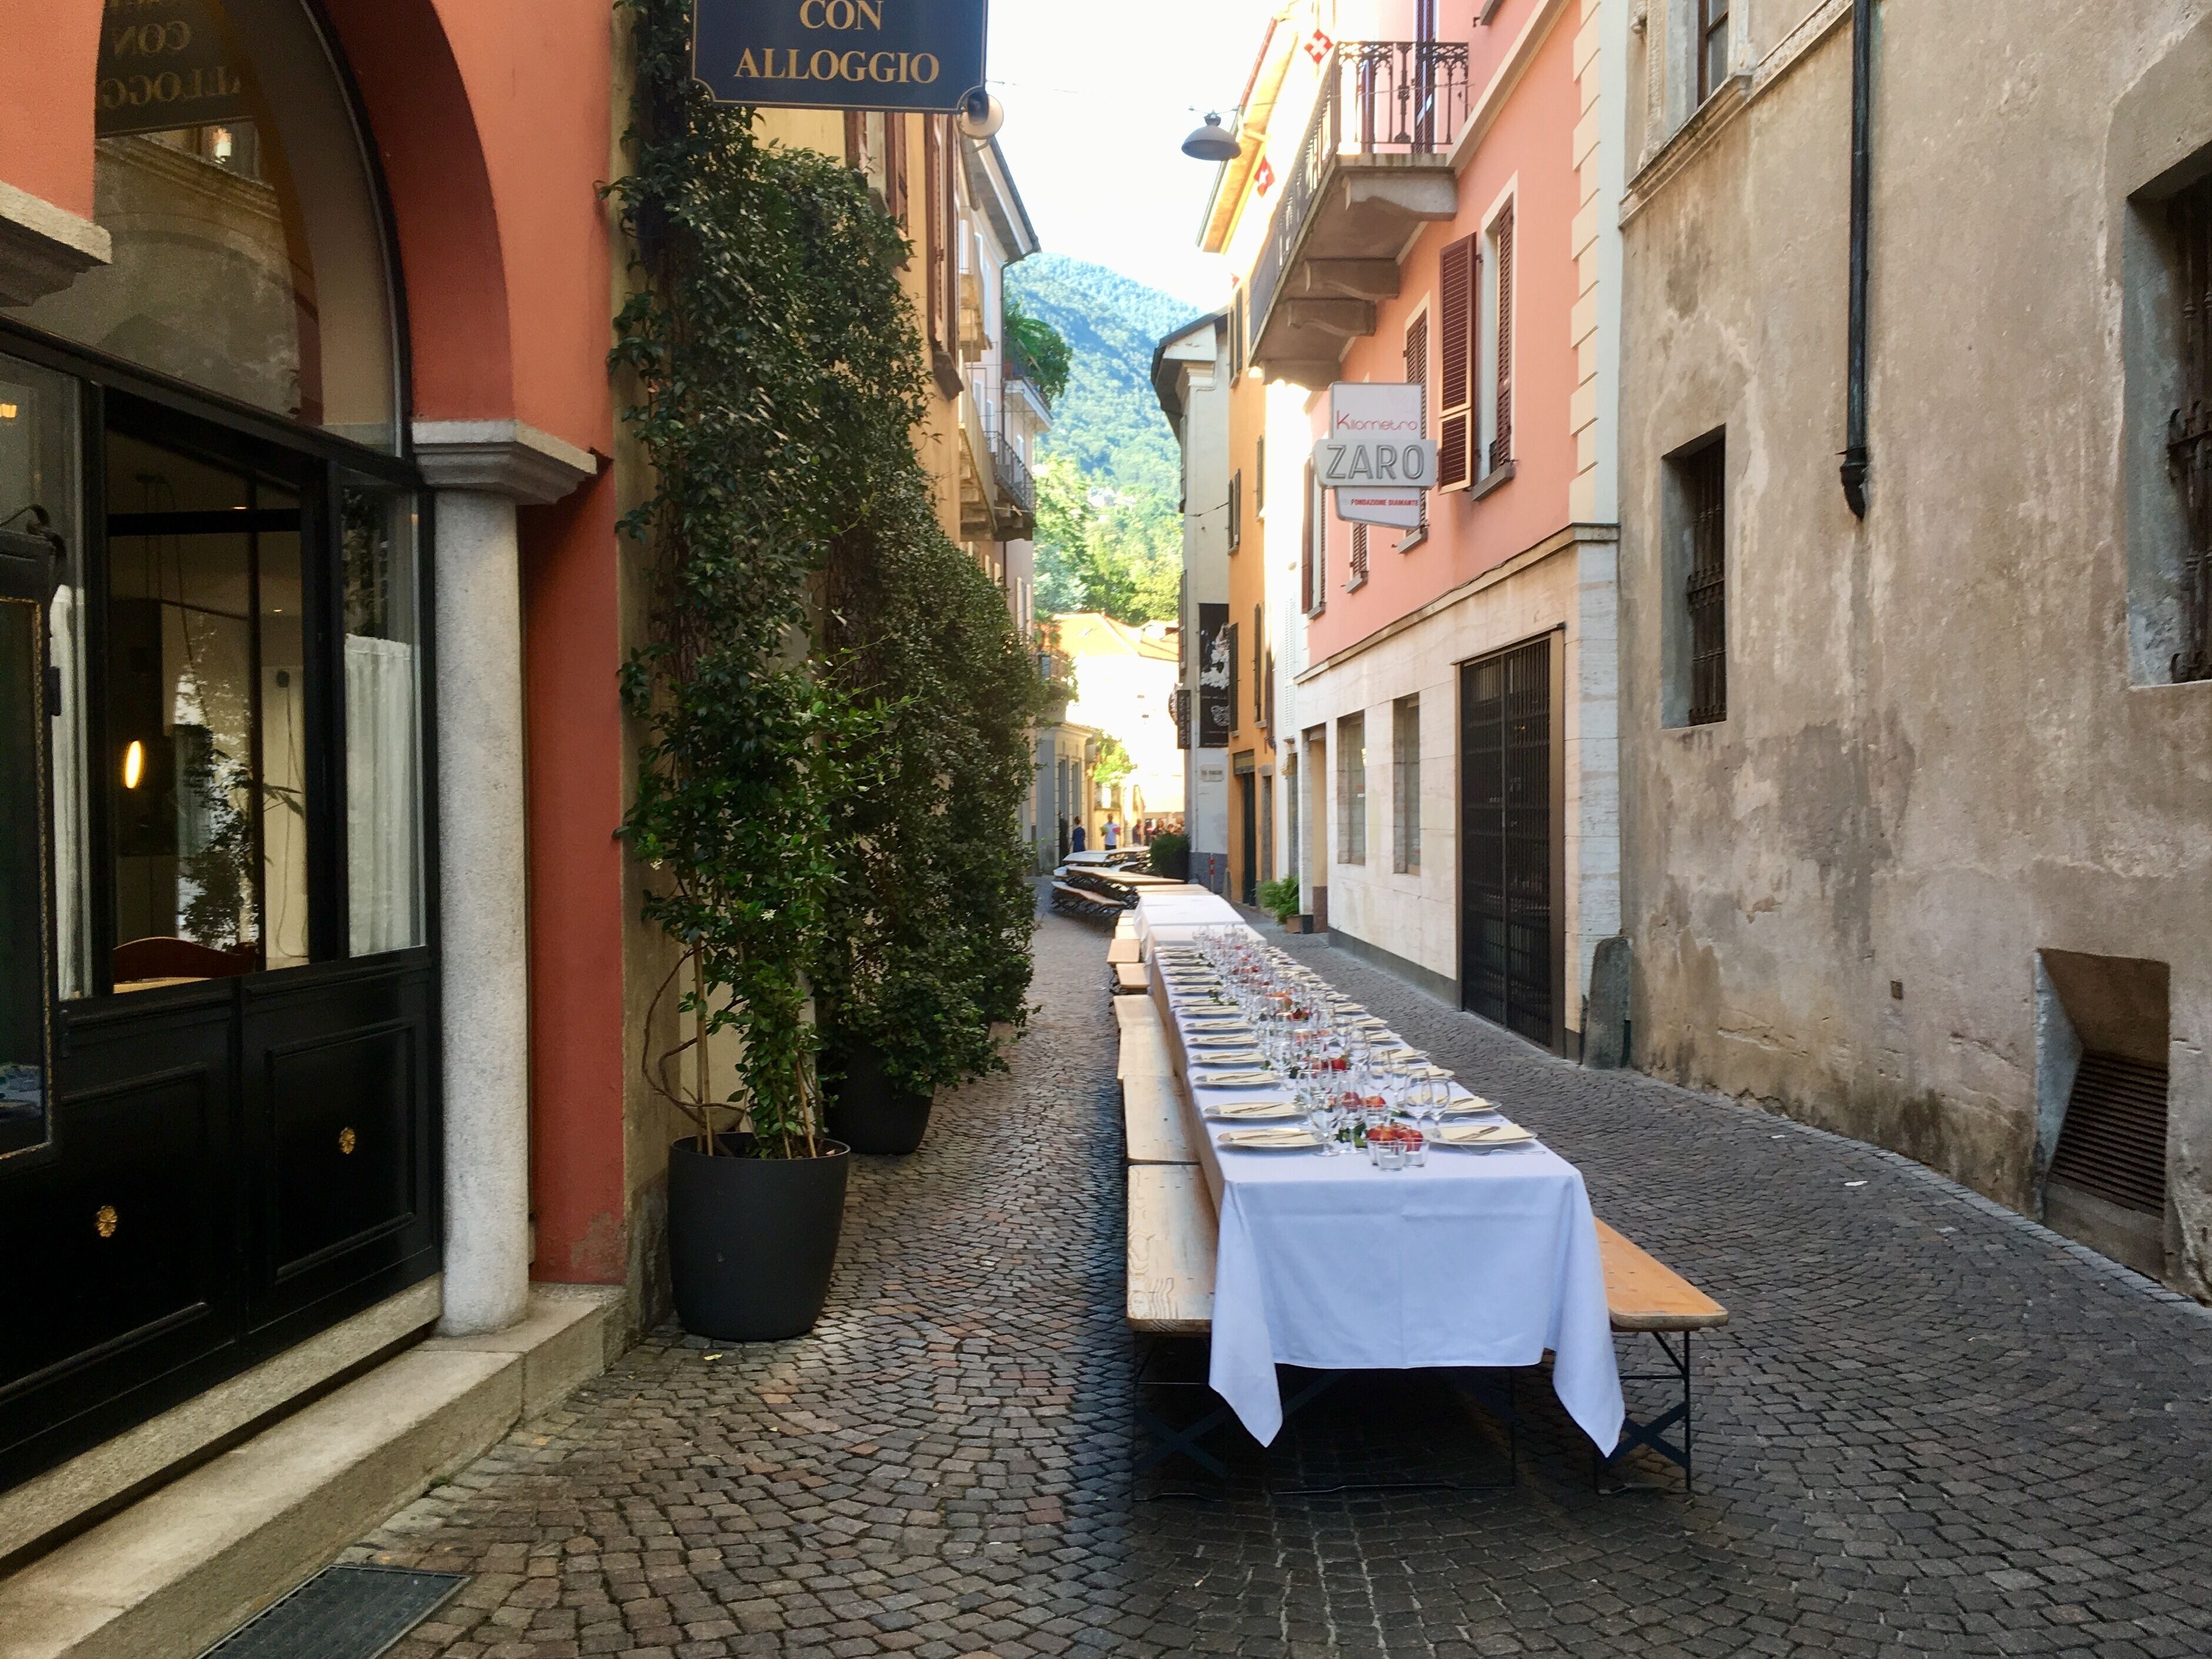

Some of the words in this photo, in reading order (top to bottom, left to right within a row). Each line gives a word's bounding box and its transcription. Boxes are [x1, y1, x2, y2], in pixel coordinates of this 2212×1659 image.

[799, 0, 883, 30] CON
[734, 48, 939, 83] ALLOGGIO
[1336, 410, 1419, 431] Kilometro
[1326, 444, 1425, 480] ZARO
